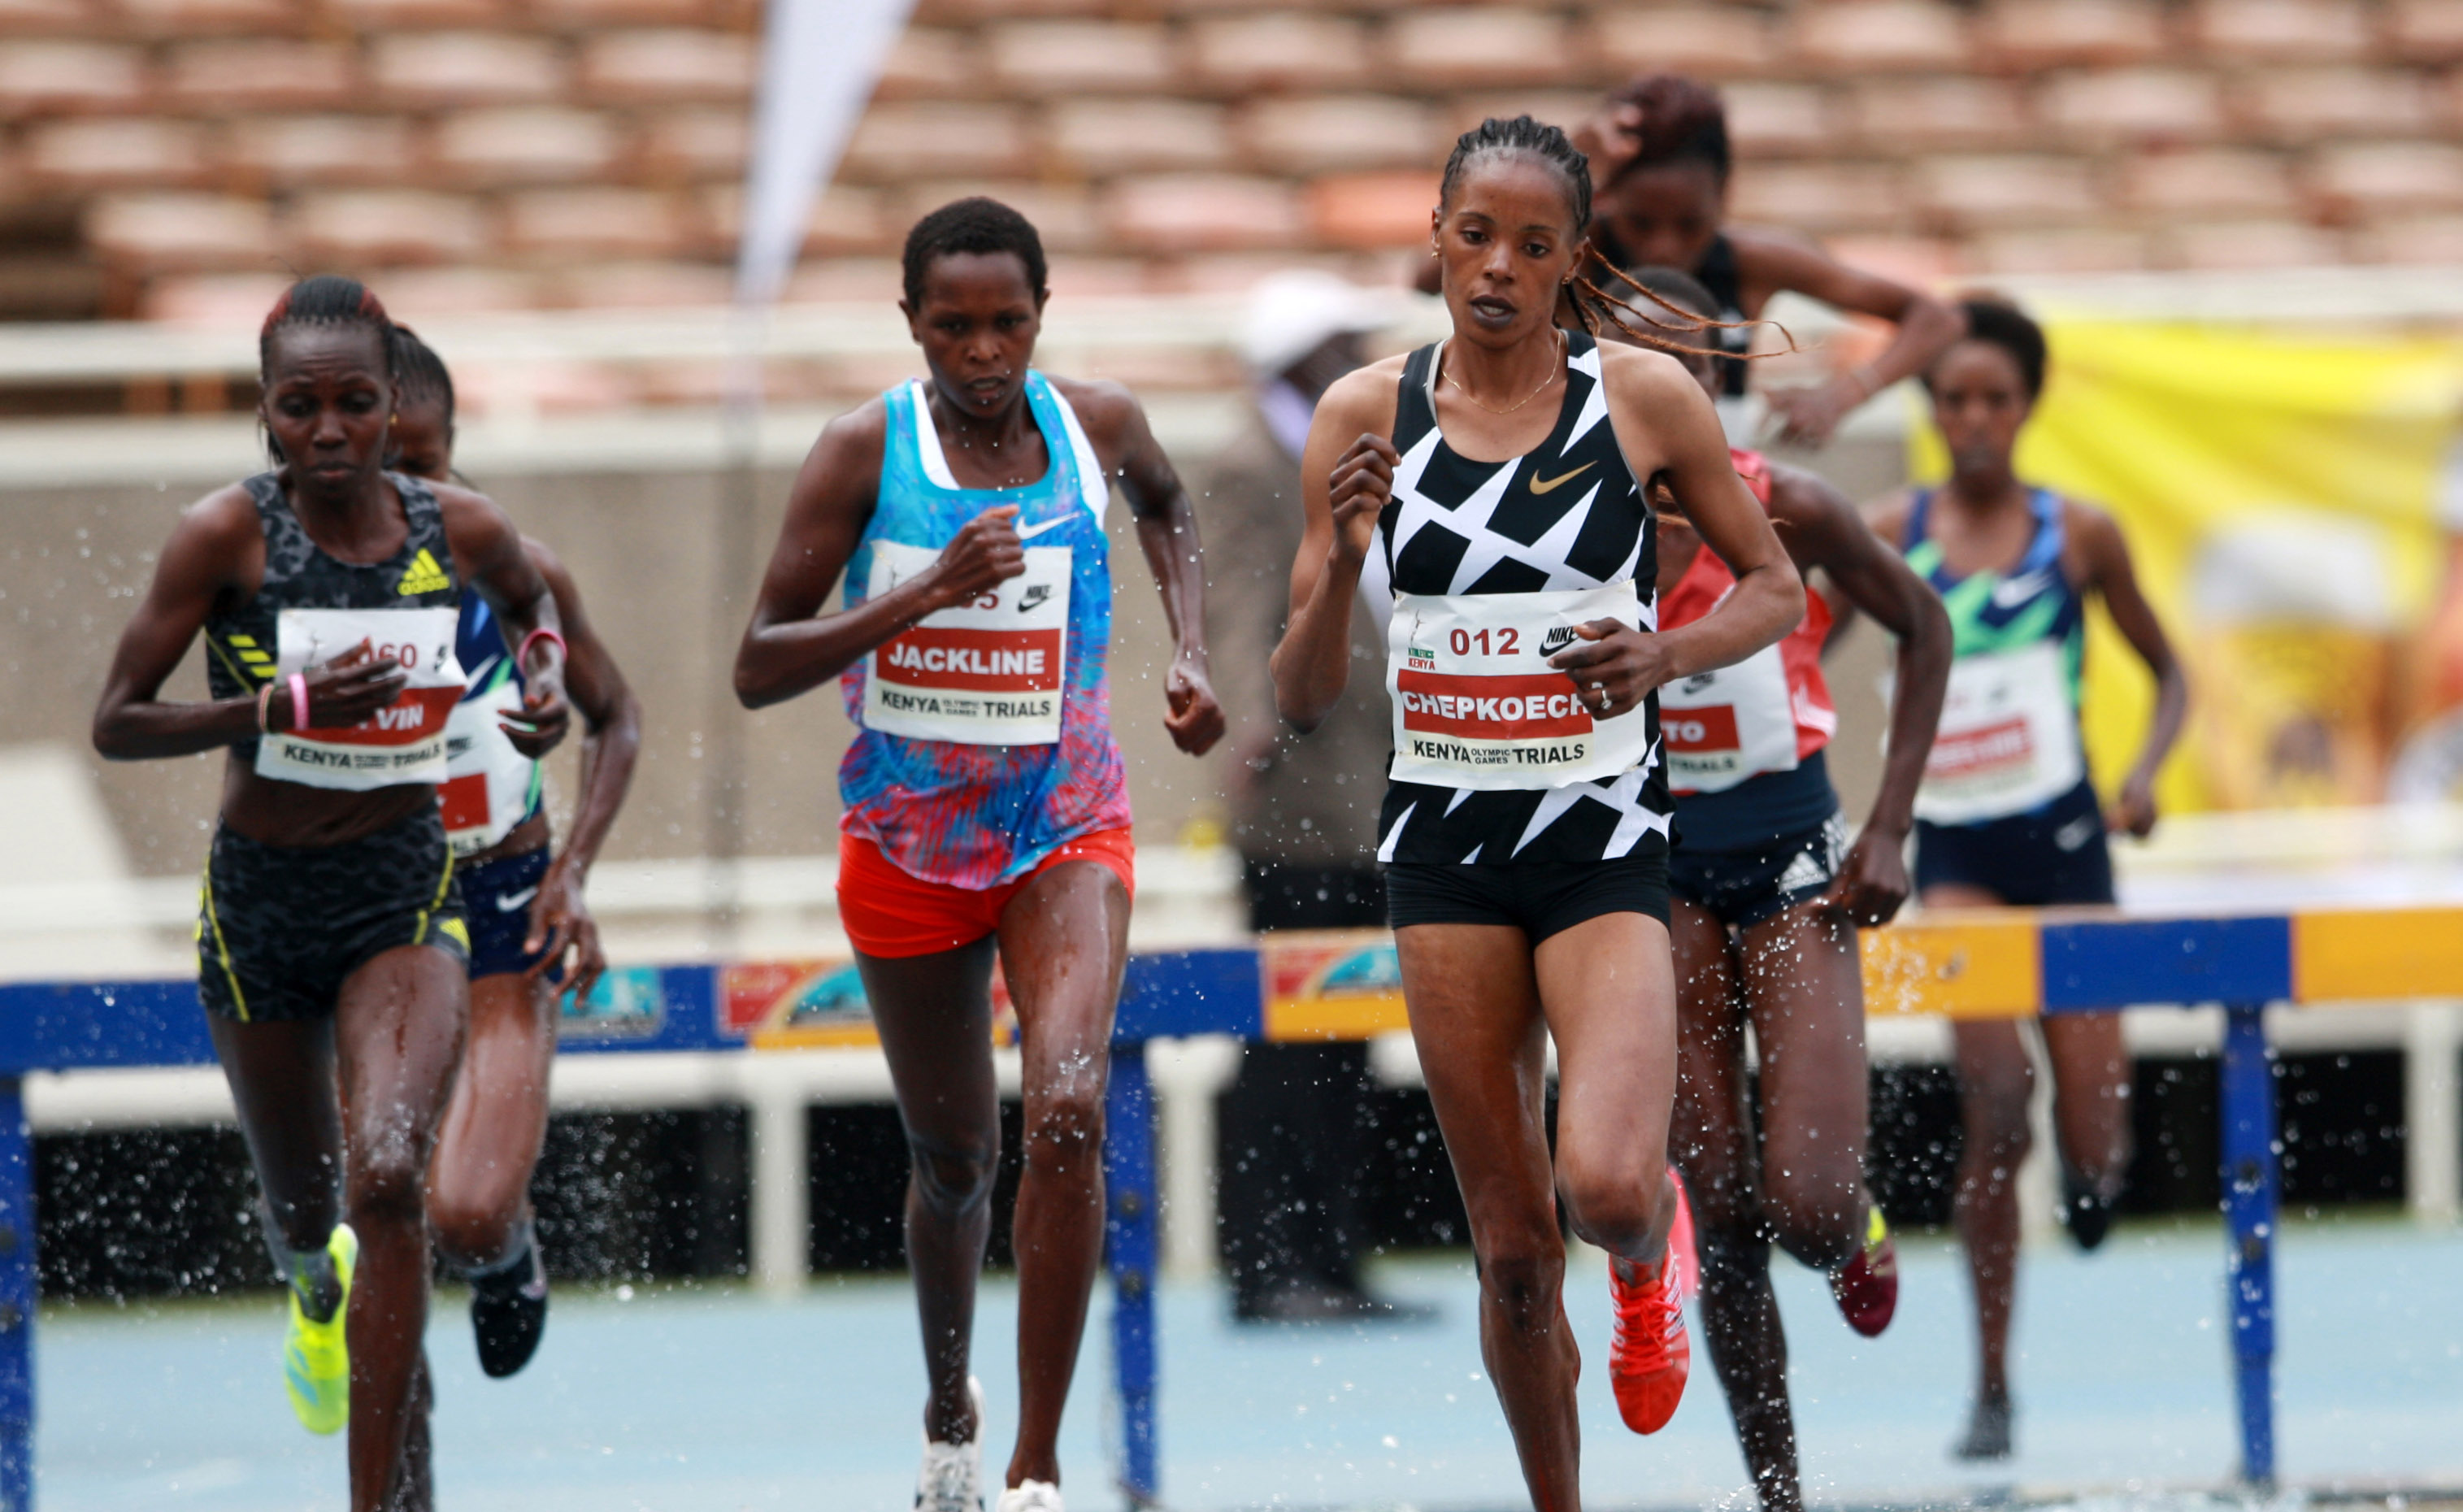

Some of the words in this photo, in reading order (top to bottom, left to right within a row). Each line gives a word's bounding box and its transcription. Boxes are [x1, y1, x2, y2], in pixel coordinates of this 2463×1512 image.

[1450, 628, 1520, 656] 012
[888, 643, 1045, 676] JACKLINE
[1409, 658, 1436, 671] KENYA
[881, 689, 941, 715] KENYA
[984, 700, 1051, 718] TRIALS
[1401, 691, 1590, 722] CHEPKOECH
[1661, 720, 1706, 743] TO
[285, 743, 352, 768] KENYA
[1414, 740, 1471, 763] KENYA
[1512, 744, 1585, 764] TRIALS
[1471, 747, 1511, 757] OLYMPIC
[1475, 756, 1509, 765] GAMES
